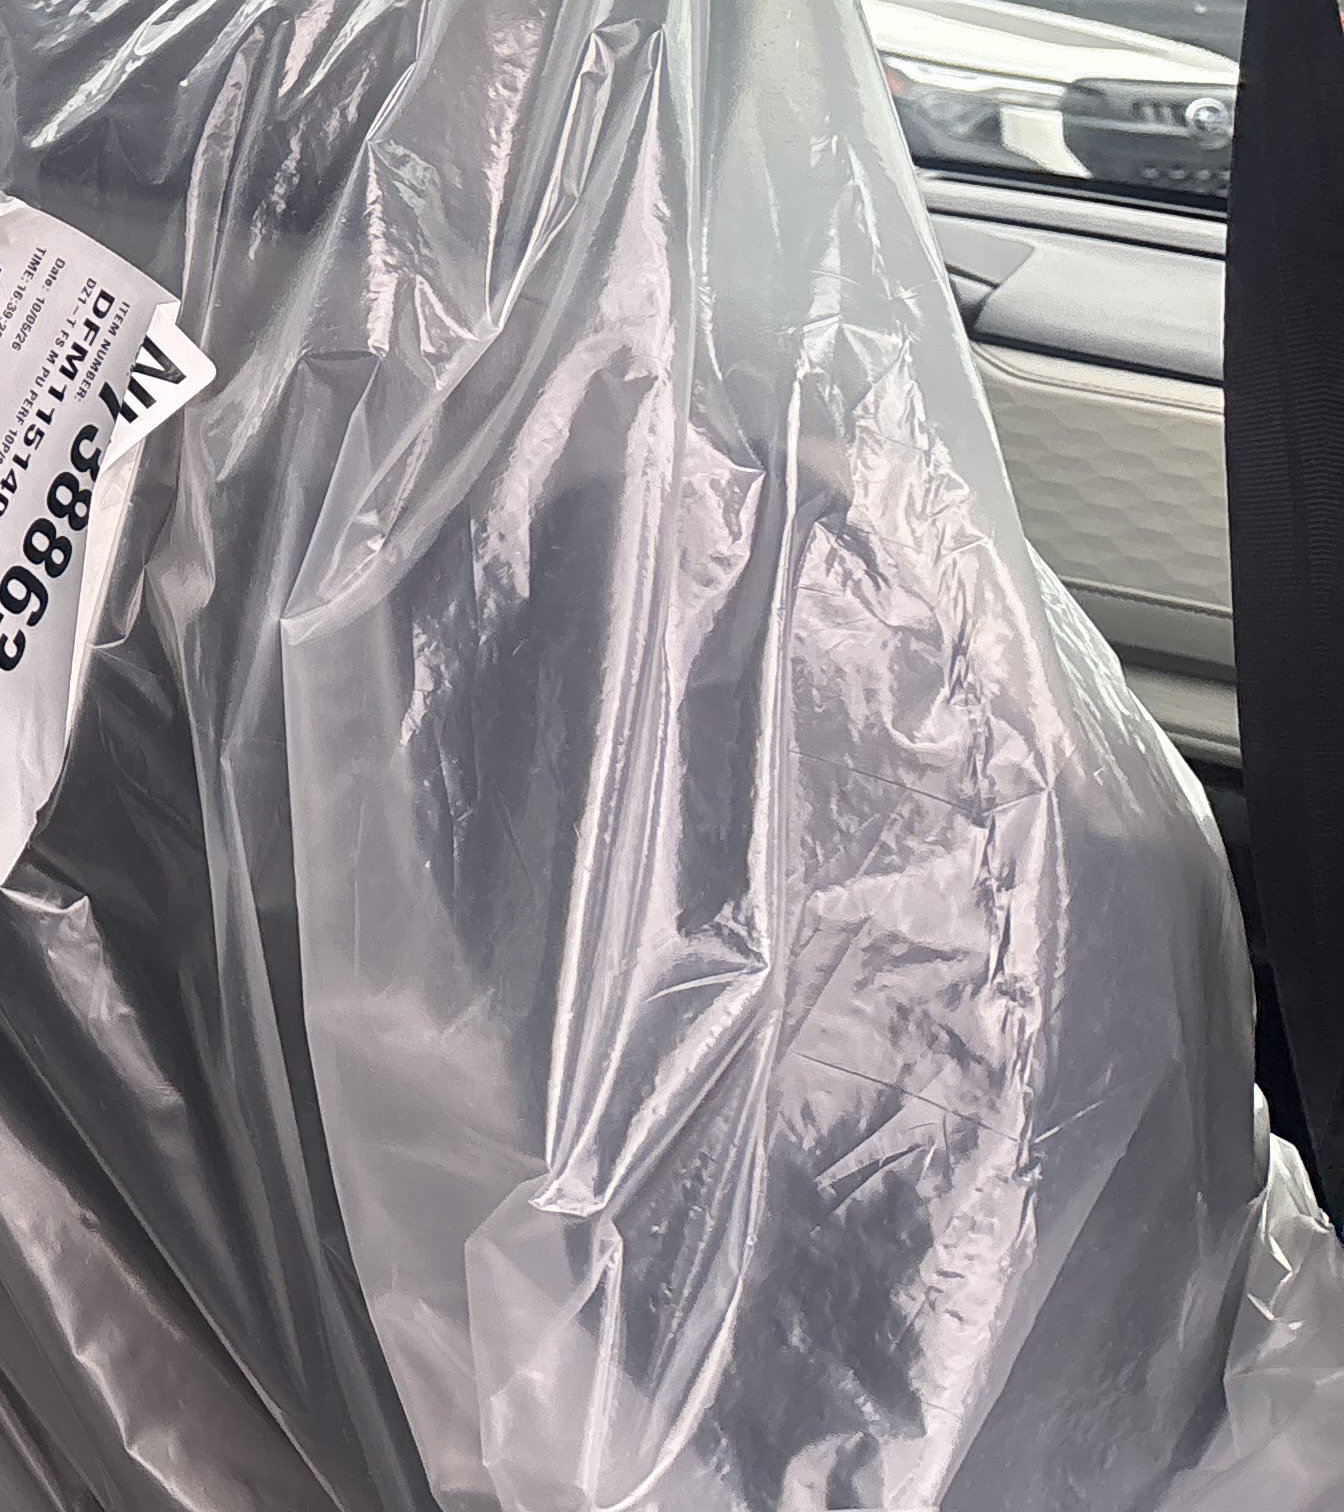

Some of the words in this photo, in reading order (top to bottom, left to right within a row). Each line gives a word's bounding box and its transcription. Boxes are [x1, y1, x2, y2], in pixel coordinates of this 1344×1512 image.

[41, 257, 66, 292] Date:
[108, 301, 131, 336] ITEM
[54, 329, 70, 348] FS
[46, 349, 59, 365] M
[74, 338, 111, 402] NUMBER:
[34, 366, 51, 388] PU
[15, 389, 38, 426] PERF
